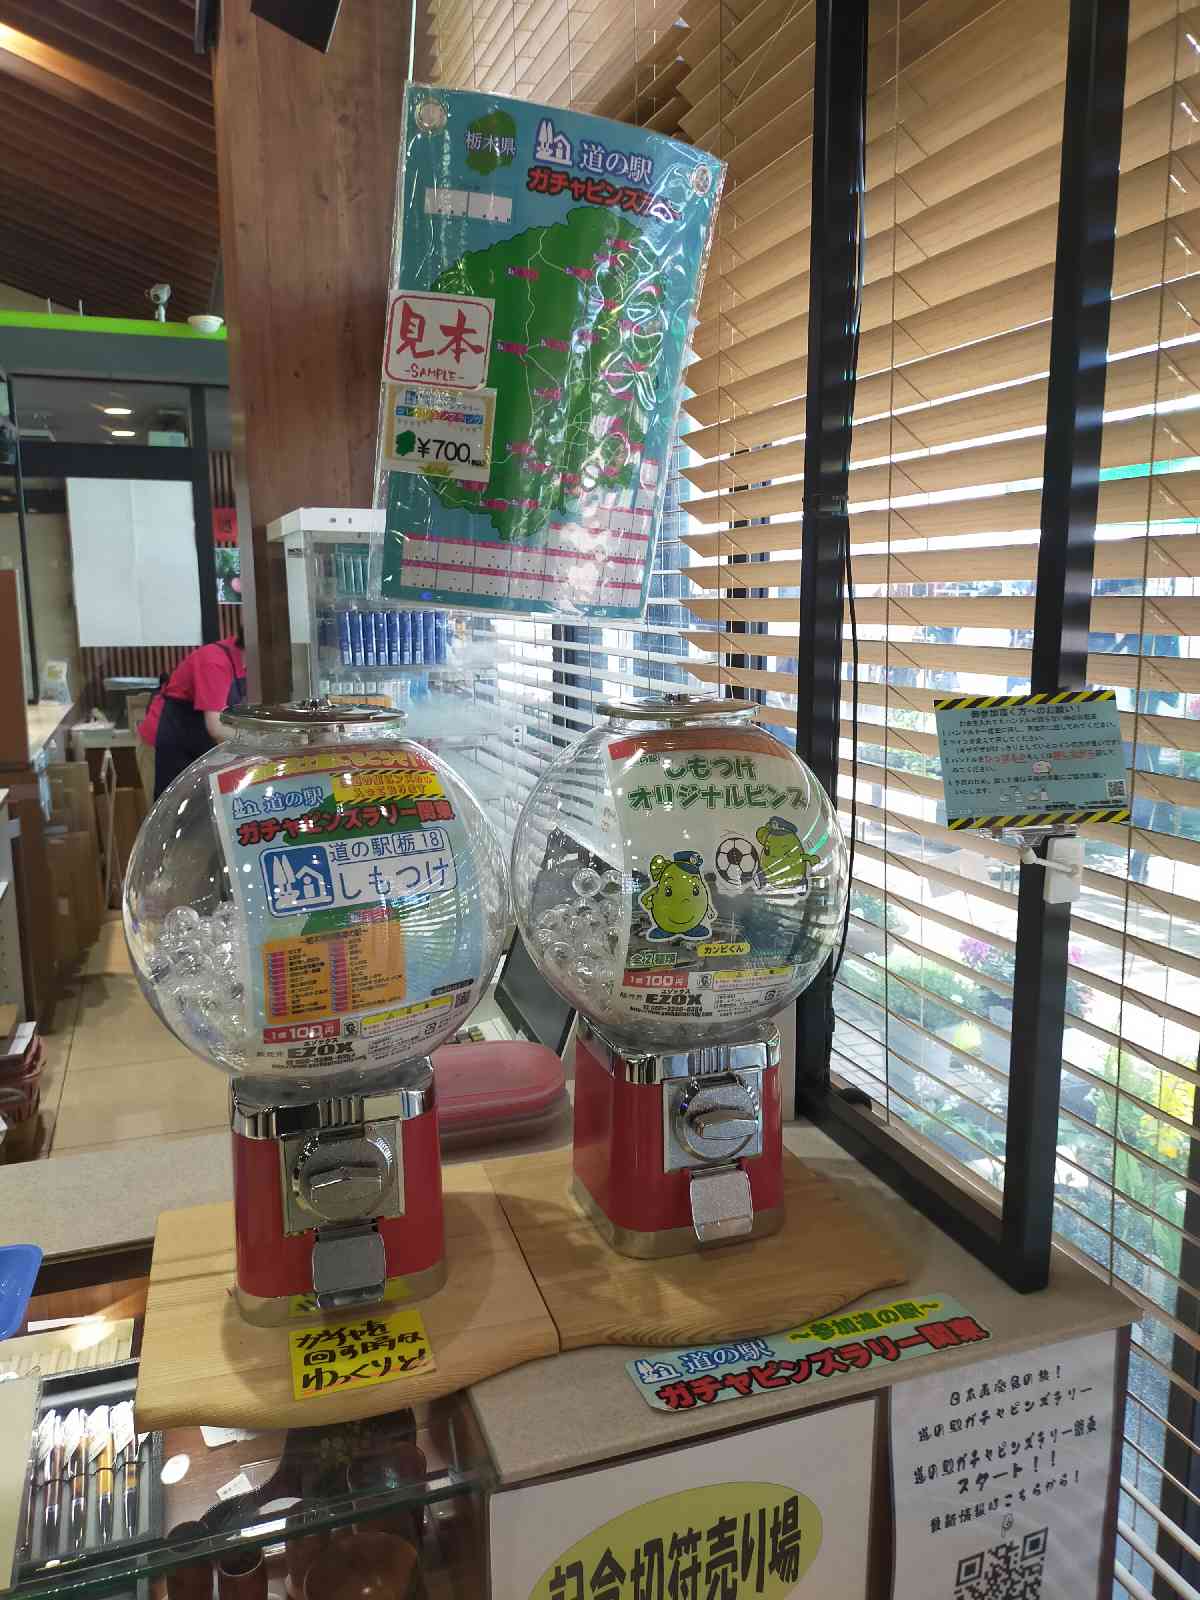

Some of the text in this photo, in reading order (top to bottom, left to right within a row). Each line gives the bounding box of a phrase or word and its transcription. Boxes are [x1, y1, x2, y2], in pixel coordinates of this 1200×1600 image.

[464, 130, 516, 157] 栃木県
[577, 141, 653, 186] 道の駅
[397, 301, 485, 364] 見本
[664, 755, 756, 780] しもつけ
[263, 785, 323, 813] 道の駅
[329, 836, 391, 862] 道の駅
[339, 856, 449, 899] しもつけ
[645, 993, 703, 1006] EZOX
[288, 1041, 354, 1059] EZOX
[302, 1347, 426, 1390] ゆっくりと
[680, 1337, 775, 1375] 道の駅
